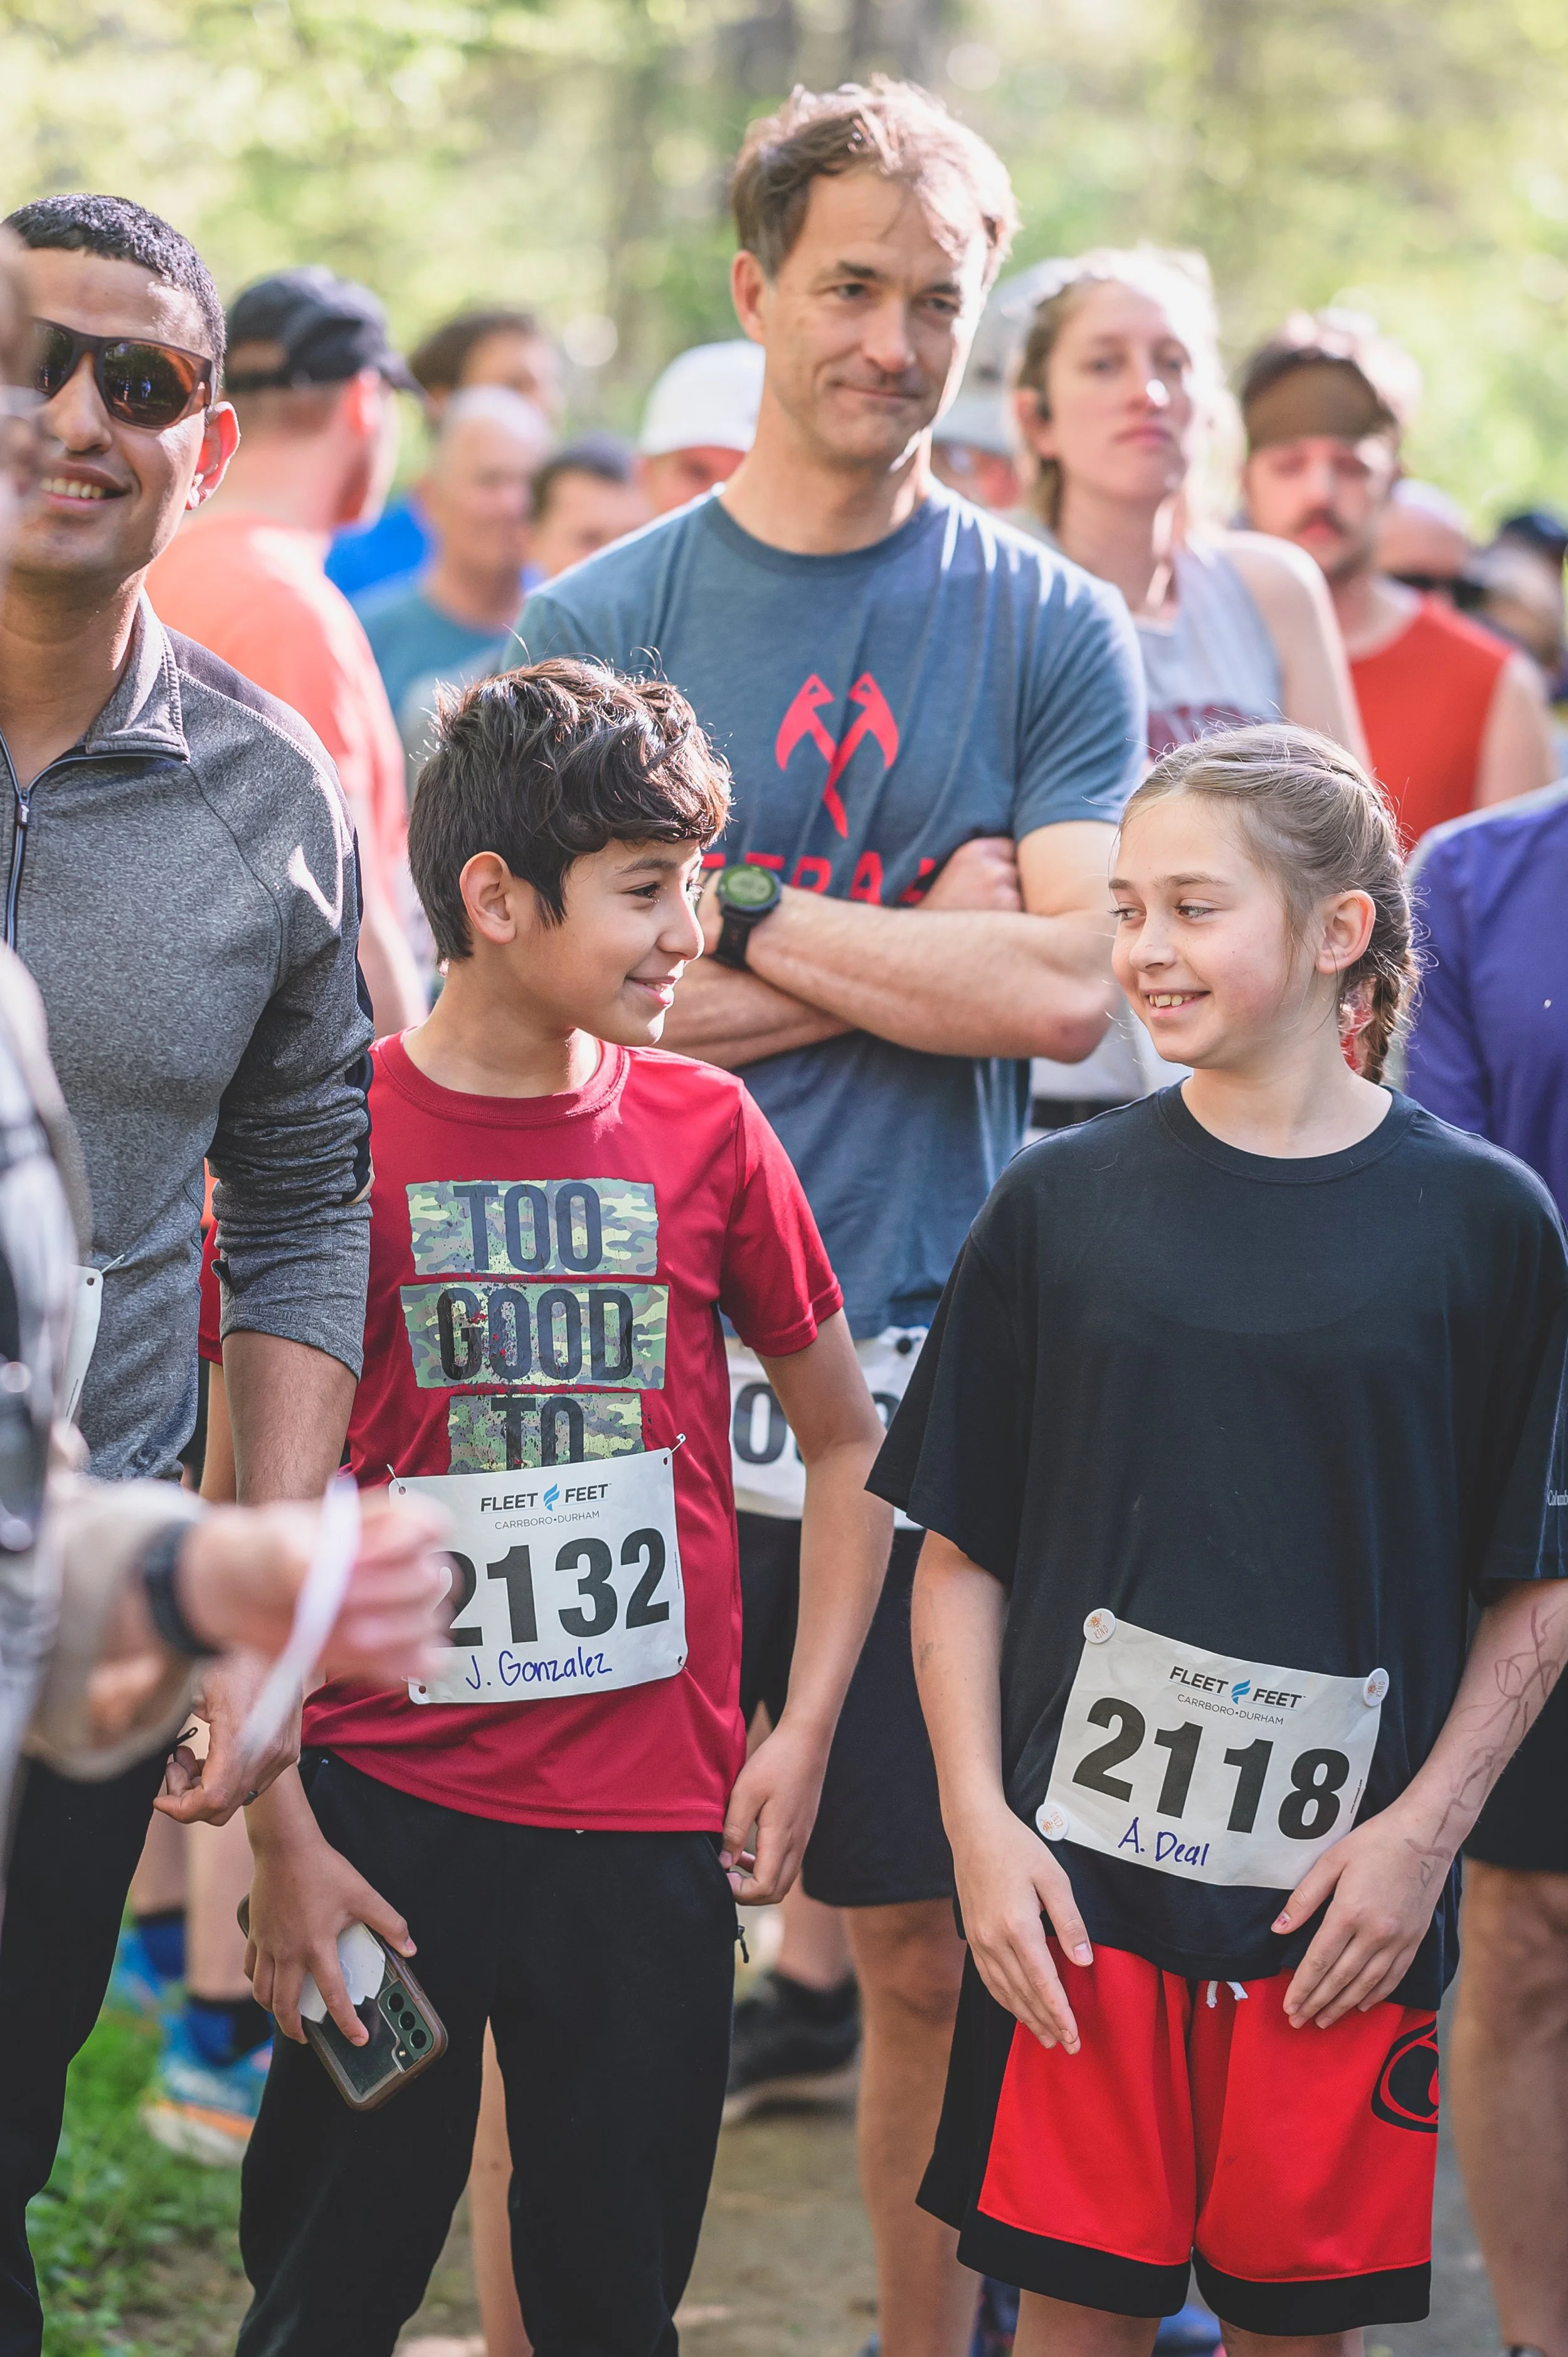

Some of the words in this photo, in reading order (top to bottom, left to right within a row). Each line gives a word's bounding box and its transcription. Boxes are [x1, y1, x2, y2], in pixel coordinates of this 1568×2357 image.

[453, 1183, 603, 1272] TOO
[437, 1288, 633, 1381] GOOD
[480, 1492, 538, 1512] FLEET
[565, 1483, 609, 1503] FEET
[428, 1528, 670, 1648] 2132
[465, 1655, 491, 1689] J.
[499, 1646, 613, 1687] Gonzalez
[1169, 1666, 1229, 1694] FLEET
[1253, 1688, 1303, 1708] FEET
[1072, 1697, 1350, 1840] 2118
[1118, 1816, 1145, 1854] A.
[1155, 1831, 1210, 1867] Deal
